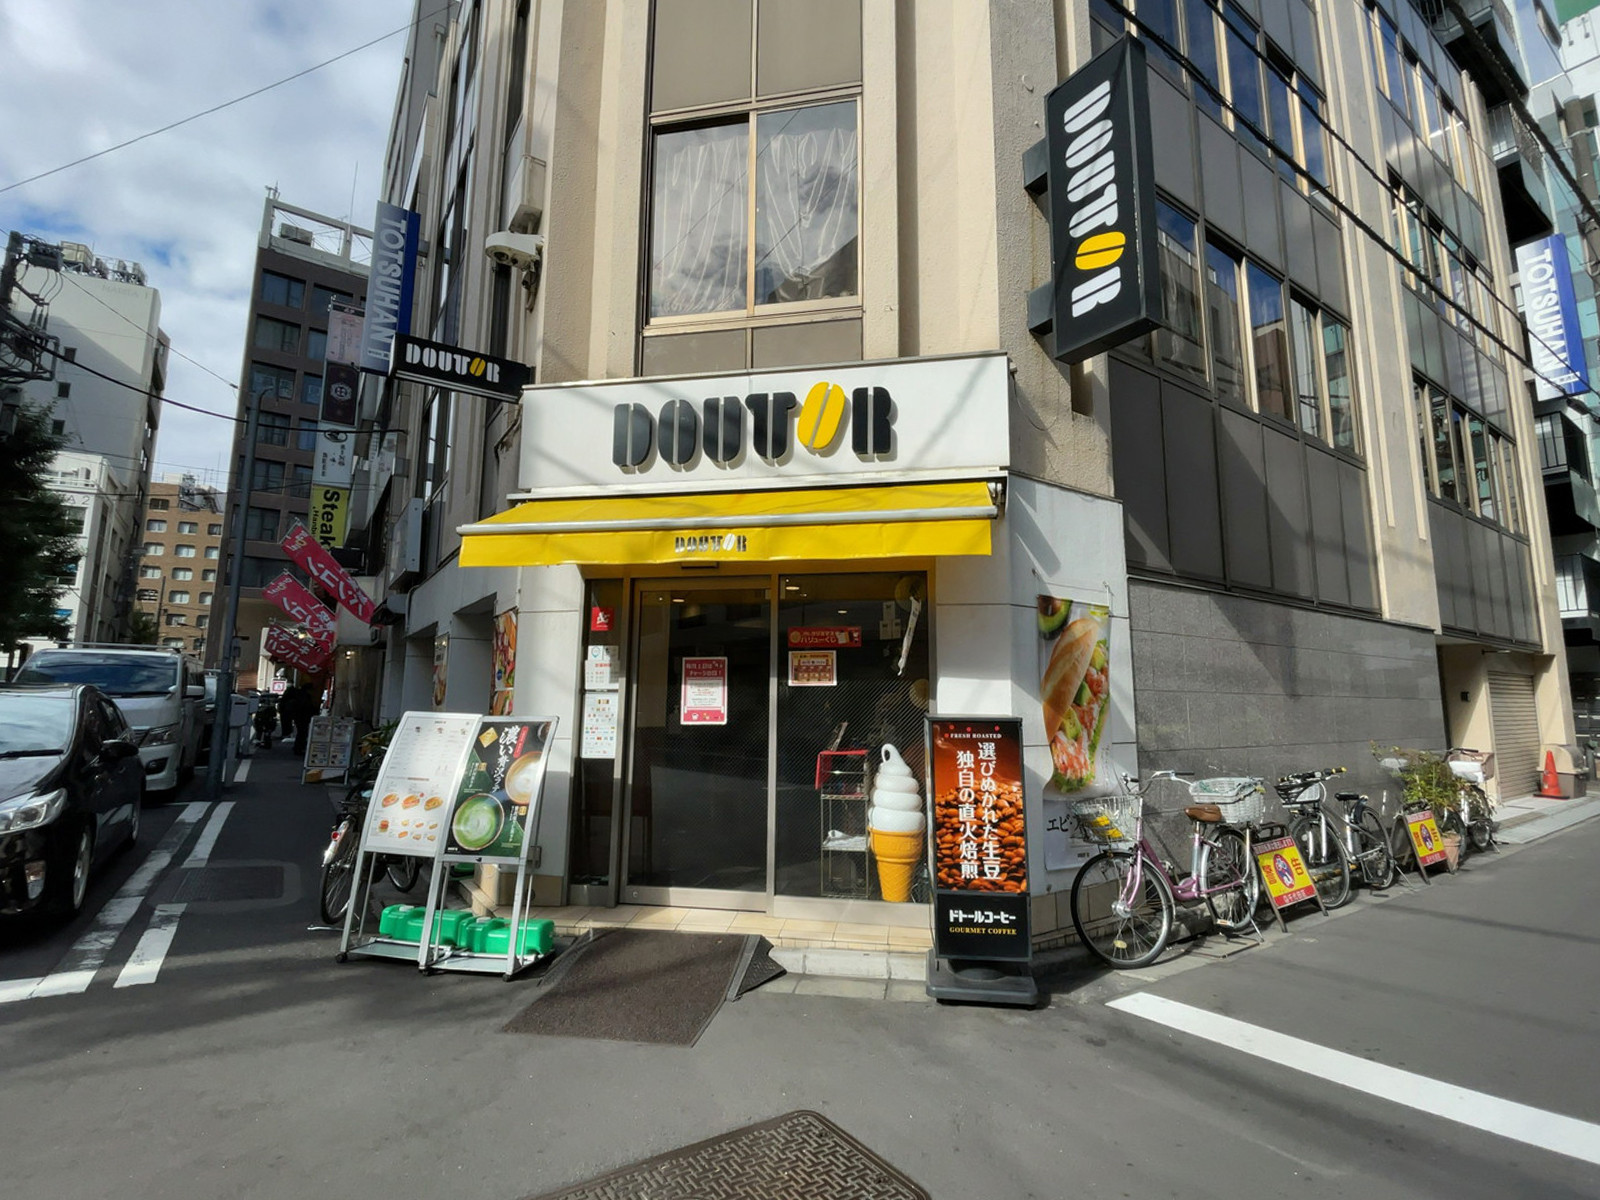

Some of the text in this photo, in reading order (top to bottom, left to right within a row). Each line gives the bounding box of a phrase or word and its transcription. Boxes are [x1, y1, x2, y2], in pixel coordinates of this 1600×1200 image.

[1064, 80, 1126, 318] DOUTOR
[370, 217, 407, 342] TOTSUHAN
[1524, 248, 1571, 374] TOTSUHAN
[406, 343, 500, 383] DOUTOR
[612, 381, 893, 468] DOUTOR
[675, 533, 747, 553] DOUTOR
[268, 640, 322, 674] ハンバーグ
[269, 628, 310, 654] ステーキ
[956, 750, 979, 880] 独自の直火焙煎
[978, 742, 1002, 880] 選びぬかれた生豆
[949, 909, 1016, 924] ドトールコーヒー
